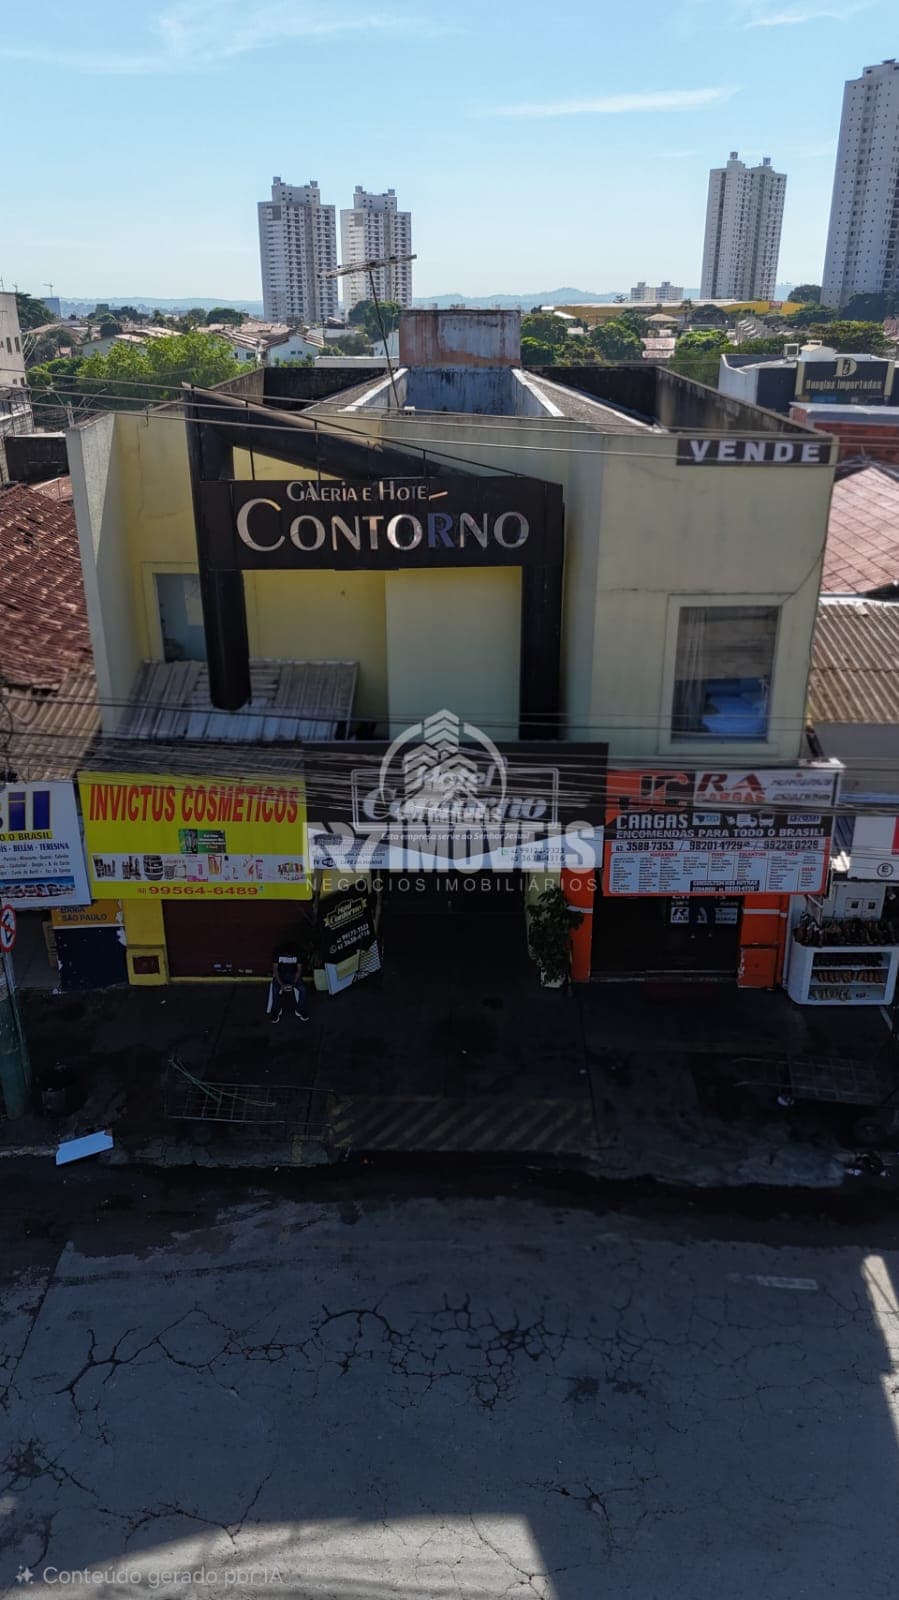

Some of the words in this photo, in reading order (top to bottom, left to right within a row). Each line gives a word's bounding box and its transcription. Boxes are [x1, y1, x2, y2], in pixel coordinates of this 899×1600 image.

[689, 439, 821, 463] VENDE
[236, 498, 530, 551] CONTORNO
[0, 790, 51, 832] il
[88, 783, 177, 823] INVICTUS
[616, 814, 689, 830] CARGAS
[18, 832, 51, 841] BRASIL
[616, 829, 695, 840] ENCOMENDAS
[698, 828, 730, 839] PARA
[733, 828, 764, 838] TODO
[767, 828, 776, 837] O
[778, 827, 825, 838] BRASIL!
[39, 842, 70, 852] TERESINA
[149, 886, 258, 896] 99564-6489
